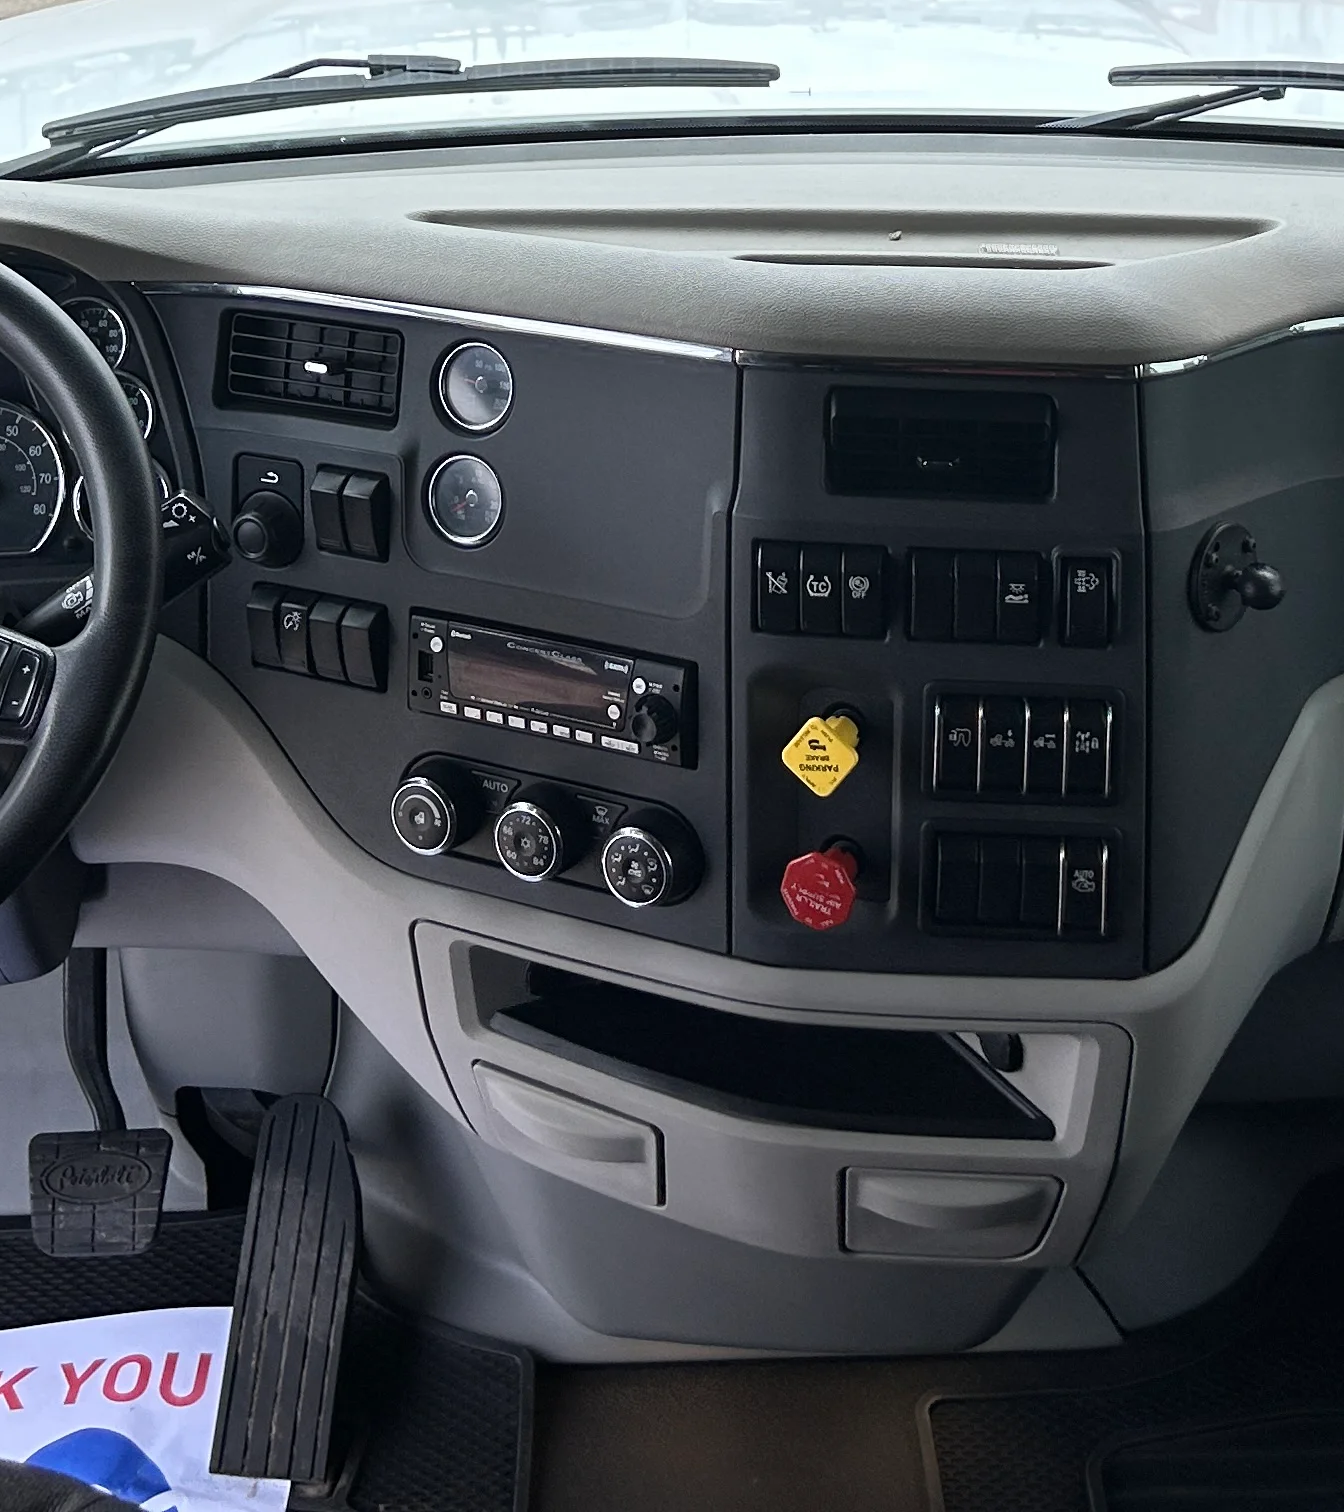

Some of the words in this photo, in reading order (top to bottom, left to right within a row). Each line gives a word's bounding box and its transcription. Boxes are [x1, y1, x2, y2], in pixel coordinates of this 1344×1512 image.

[6, 425, 19, 437] 50
[28, 445, 42, 457] 60
[39, 473, 52, 484] 70
[33, 504, 46, 515] 80
[811, 581, 827, 593] TC
[851, 590, 866, 599] OFF
[805, 754, 830, 762] BRAKE
[798, 763, 839, 773] PARKING
[482, 779, 509, 793] AUTO
[520, 815, 531, 825] 72
[591, 814, 610, 825] MAX
[538, 834, 549, 845] 78
[506, 849, 517, 860] 60
[532, 856, 544, 866] 84
[1073, 869, 1095, 879] AUTO
[60, 1351, 213, 1408] YOU
